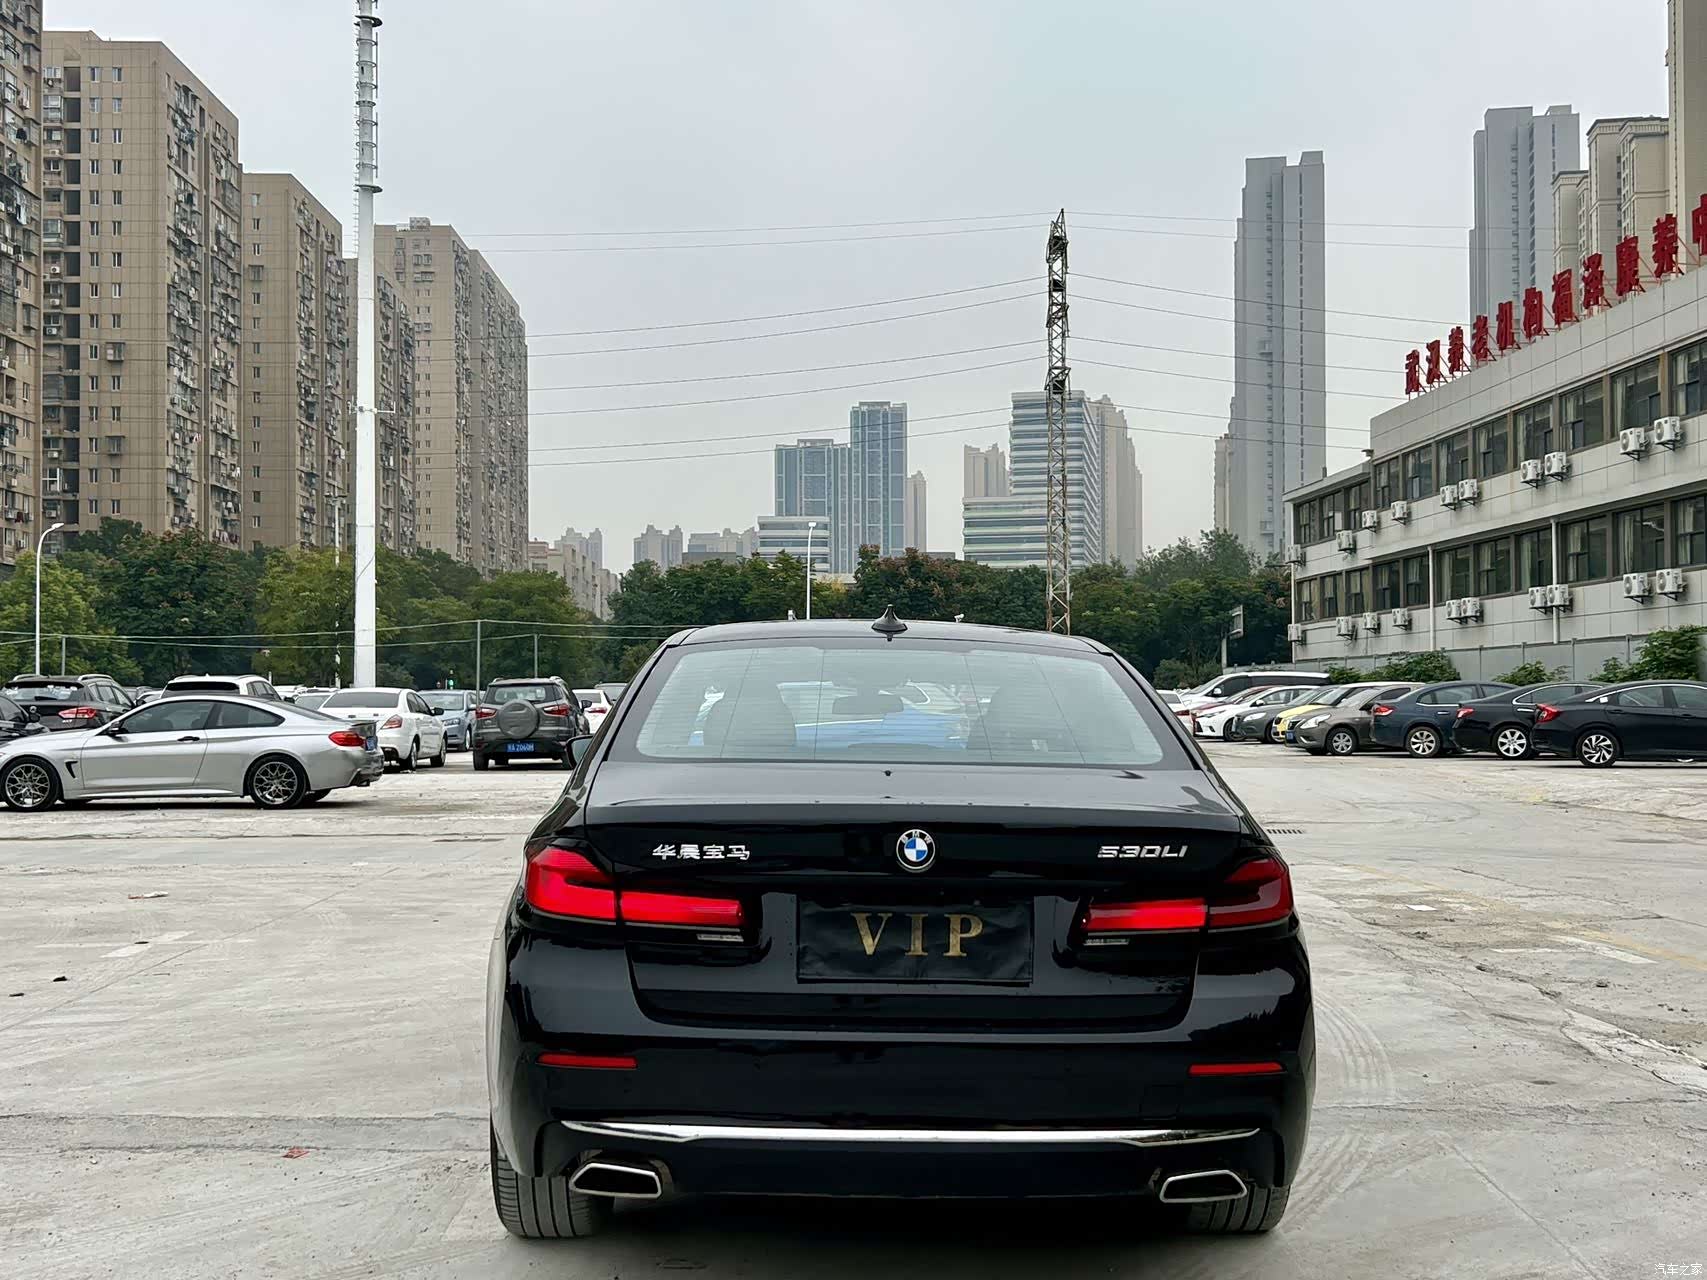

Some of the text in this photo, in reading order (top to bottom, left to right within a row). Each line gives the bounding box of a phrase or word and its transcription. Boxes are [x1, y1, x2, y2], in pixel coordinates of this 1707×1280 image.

[652, 844, 750, 860] 华晨宝马
[850, 912, 983, 957] VIP
